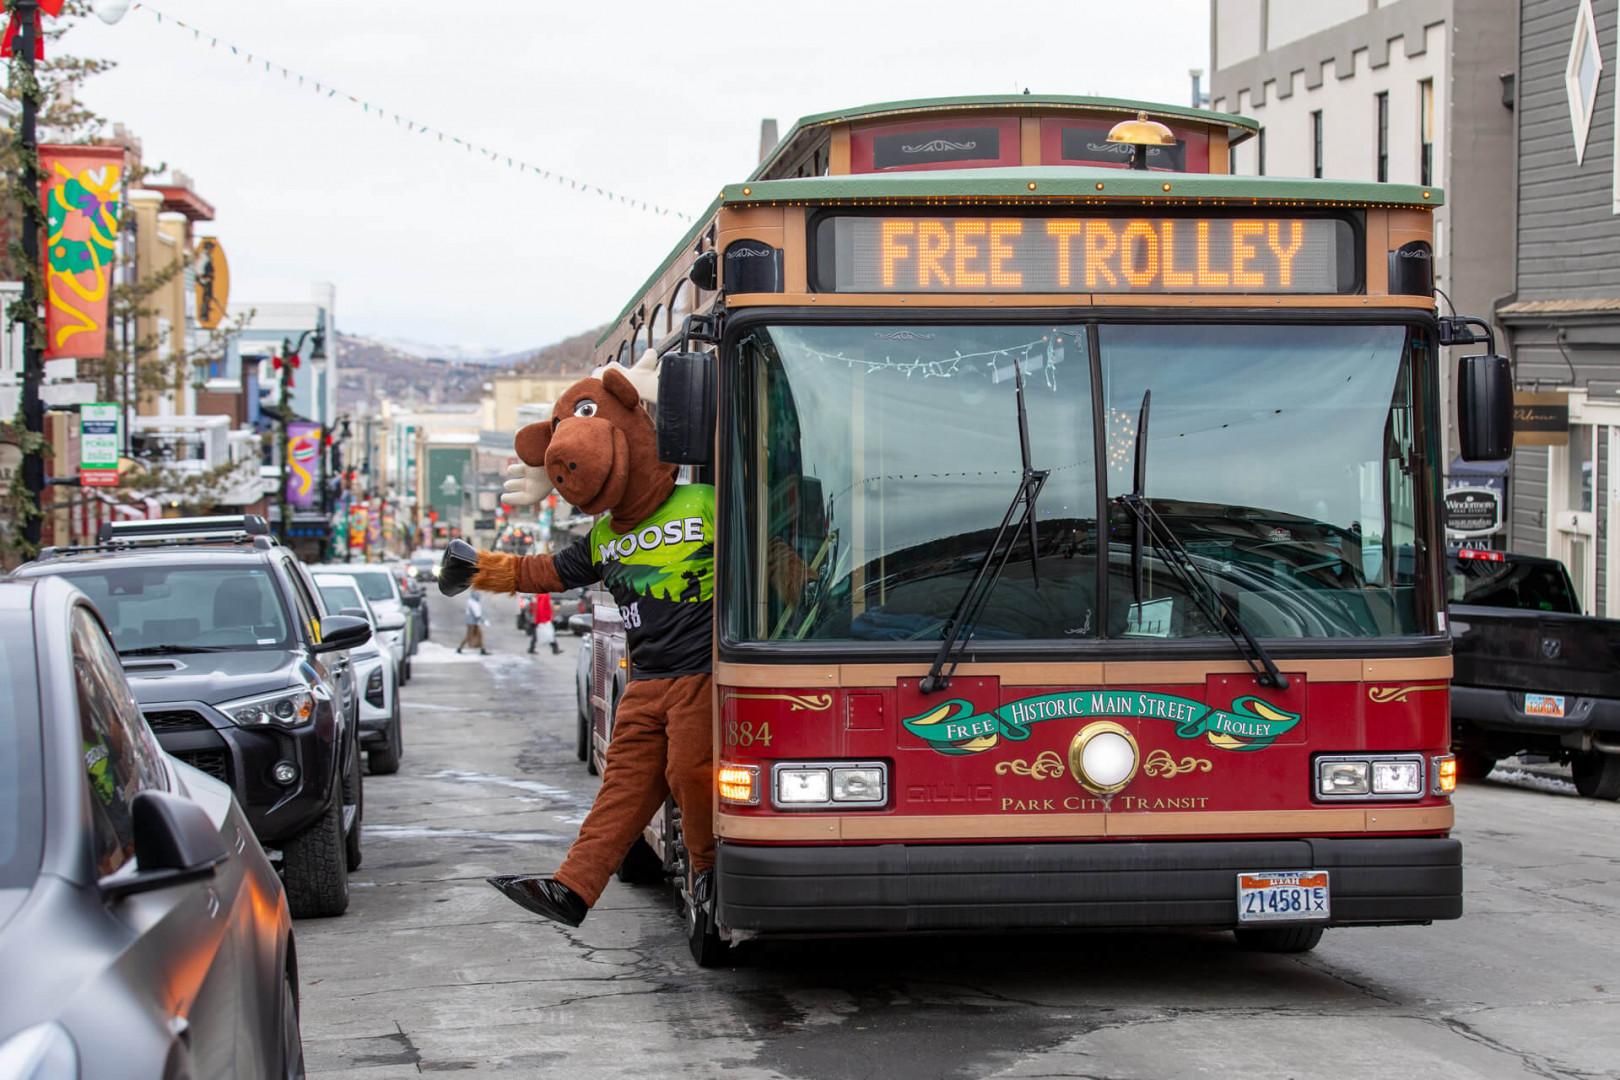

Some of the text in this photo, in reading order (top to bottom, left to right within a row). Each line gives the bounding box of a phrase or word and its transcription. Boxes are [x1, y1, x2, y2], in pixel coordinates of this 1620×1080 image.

[881, 221, 1303, 287] FREE TROLLEY
[598, 517, 704, 566] MOOSE
[946, 693, 1271, 739] FREE HISTORIC MAIN STREET TROLLEY
[906, 784, 993, 803] GILLIG
[1002, 796, 1209, 811] PARK CITY TRANSIT
[1270, 878, 1300, 886] UTAH
